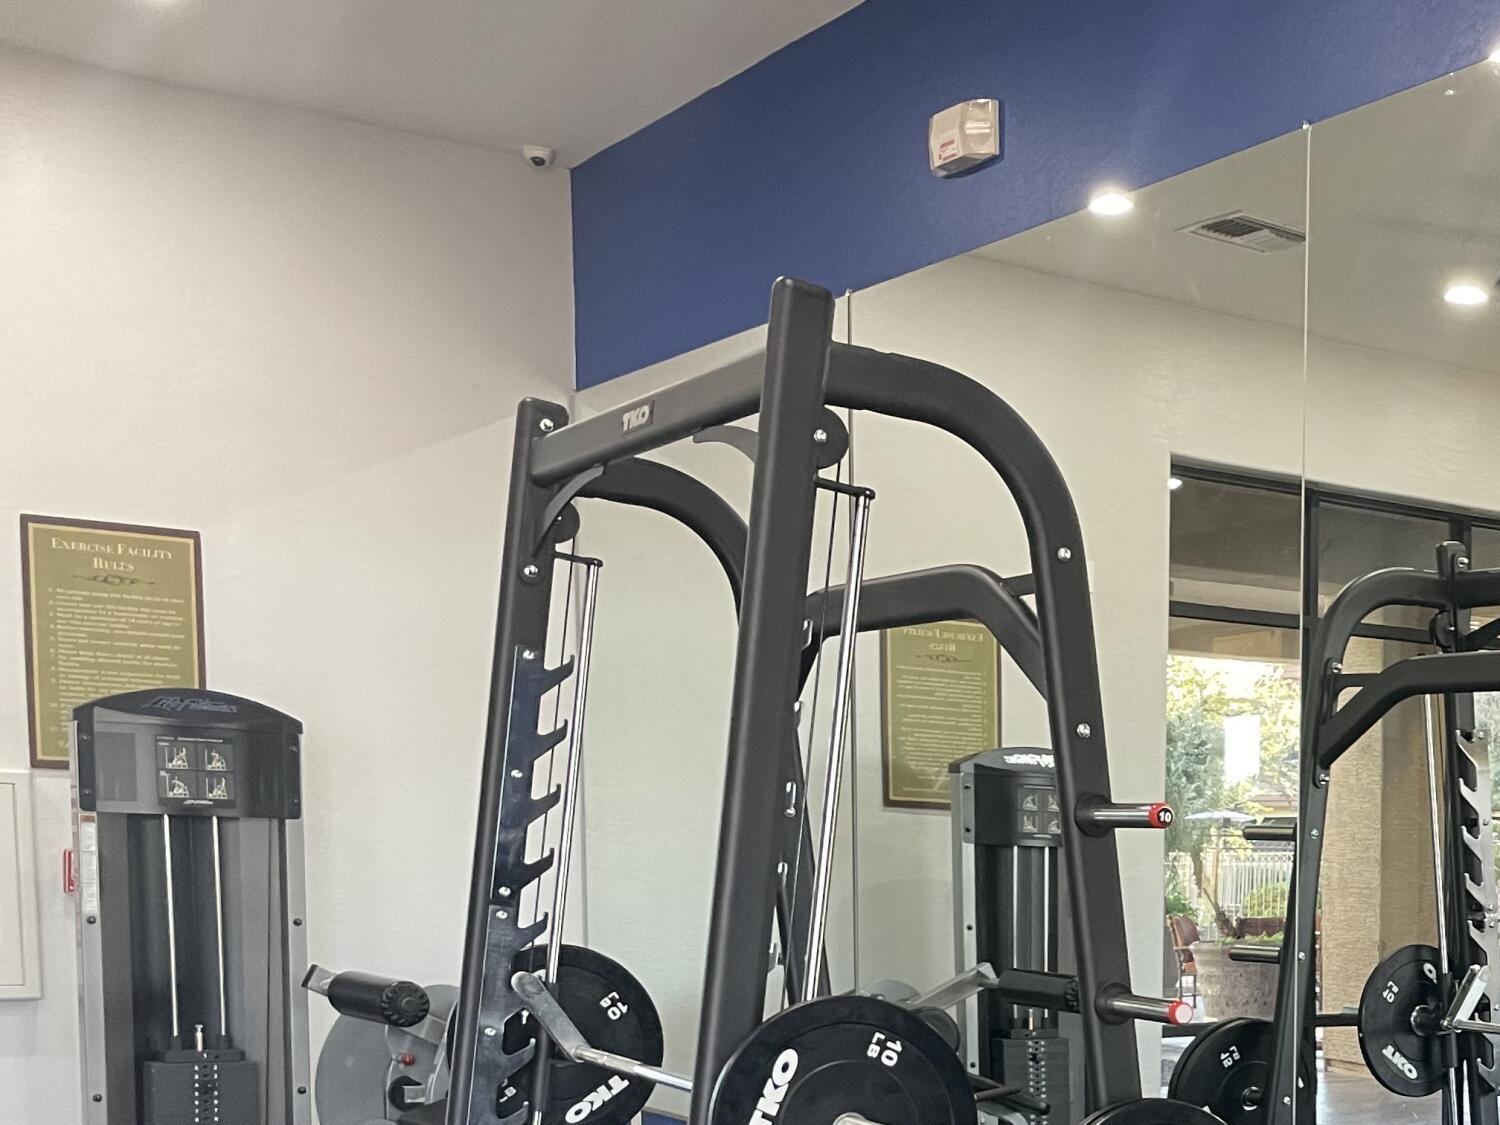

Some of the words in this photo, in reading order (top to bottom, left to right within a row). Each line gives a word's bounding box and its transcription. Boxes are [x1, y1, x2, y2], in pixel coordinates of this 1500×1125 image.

[622, 405, 649, 432] TKO
[1159, 810, 1171, 823] 10
[599, 991, 620, 1008] LB
[606, 1001, 629, 1021] 10
[867, 1032, 885, 1058] LB
[881, 1040, 903, 1067] 10
[565, 1074, 630, 1124] TKO
